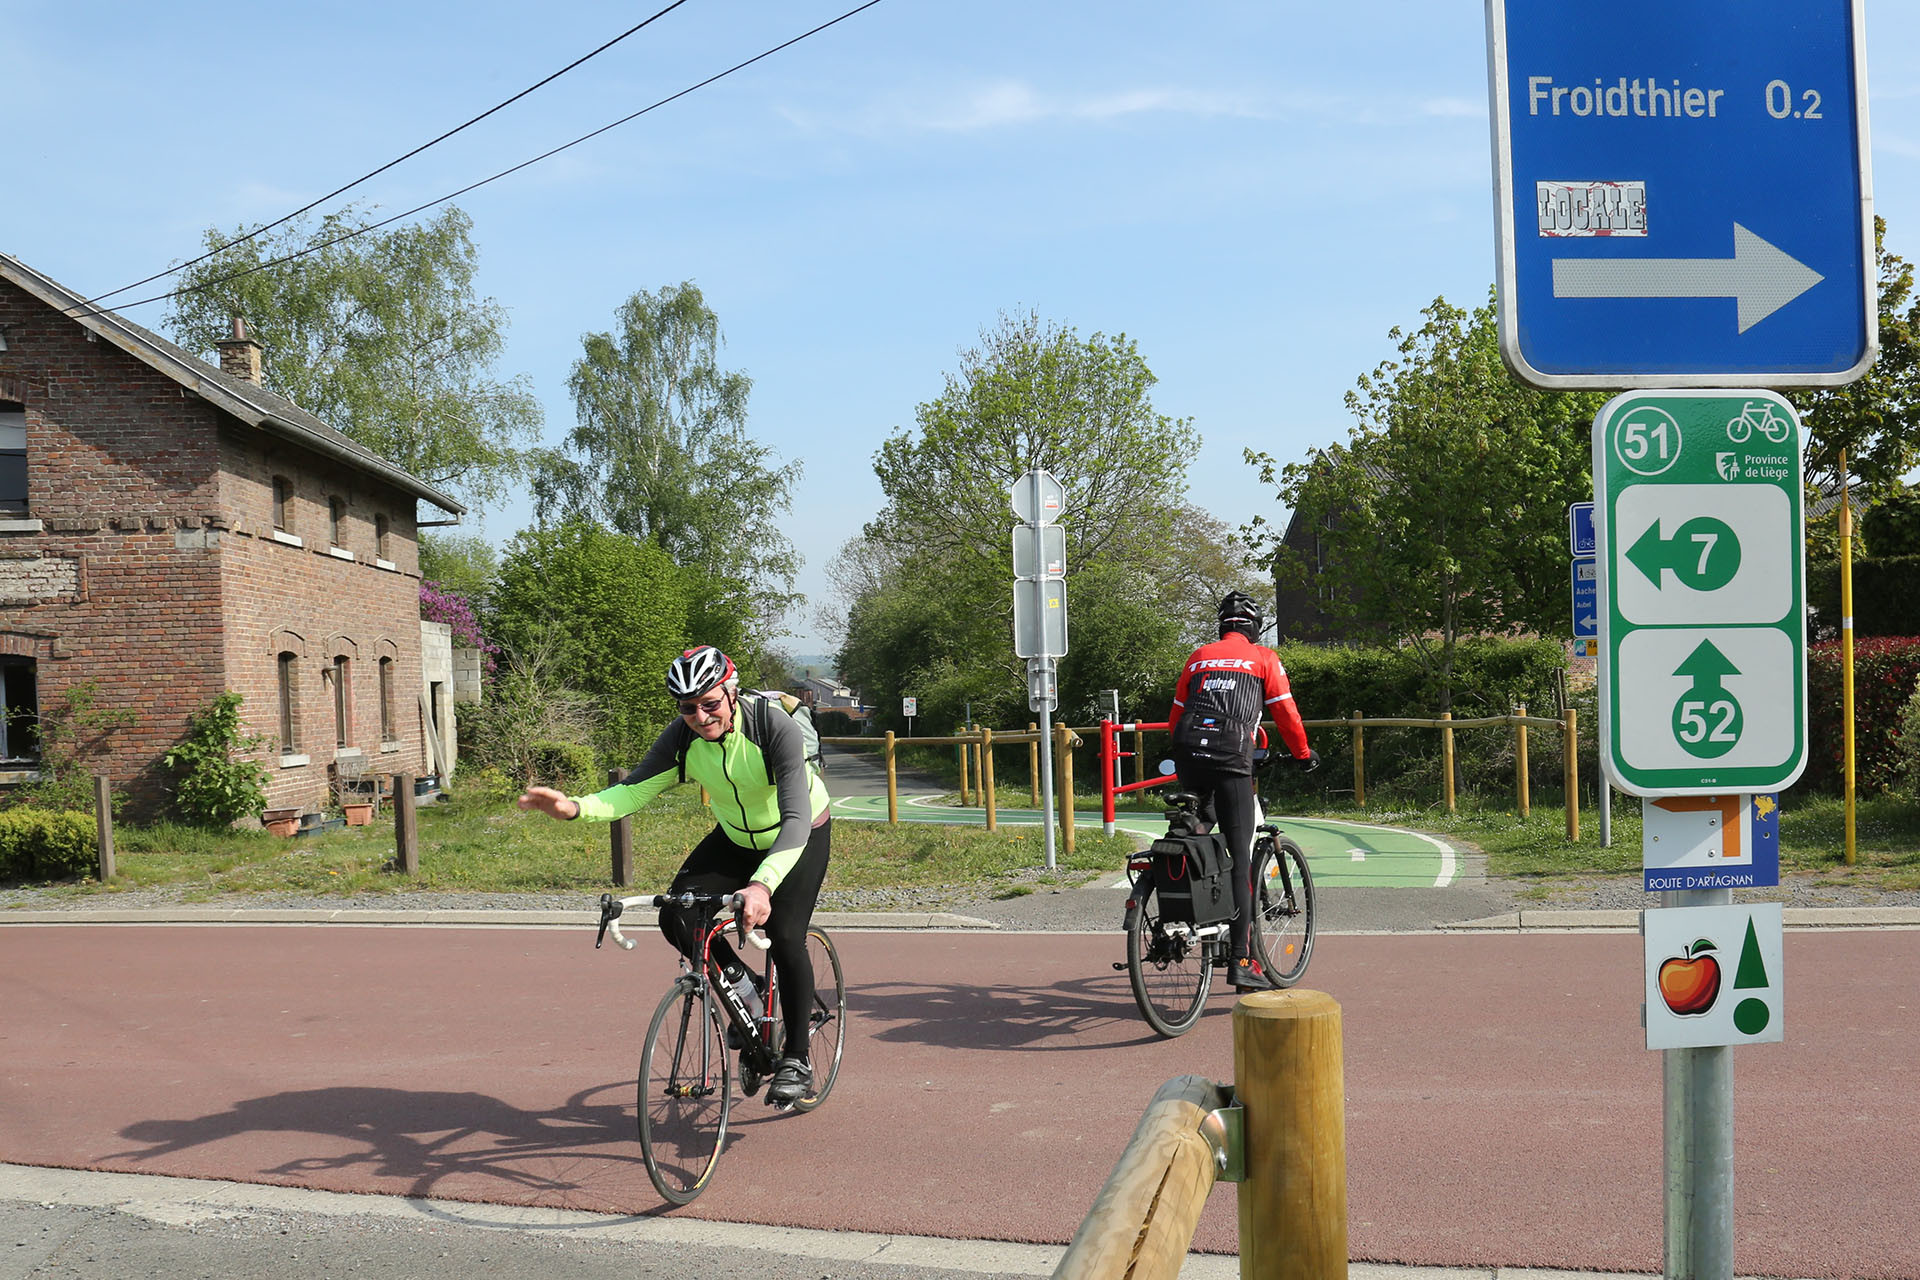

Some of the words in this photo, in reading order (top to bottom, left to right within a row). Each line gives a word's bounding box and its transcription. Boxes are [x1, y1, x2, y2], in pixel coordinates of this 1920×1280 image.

[1529, 76, 1724, 118] Froidthier
[1765, 79, 1823, 119] 0.2
[1538, 187, 1646, 231] LOCALE
[1624, 422, 1668, 460] 51
[1745, 454, 1788, 465] Province
[1745, 466, 1758, 478] de
[1761, 466, 1789, 481] Liège
[1690, 533, 1719, 575] 7
[1576, 587, 1596, 595] Aache
[1189, 658, 1255, 673] TREK
[1679, 700, 1736, 743] 52
[1649, 877, 1682, 889] ROUTE
[1686, 875, 1753, 888] D'ARTAGNAN
